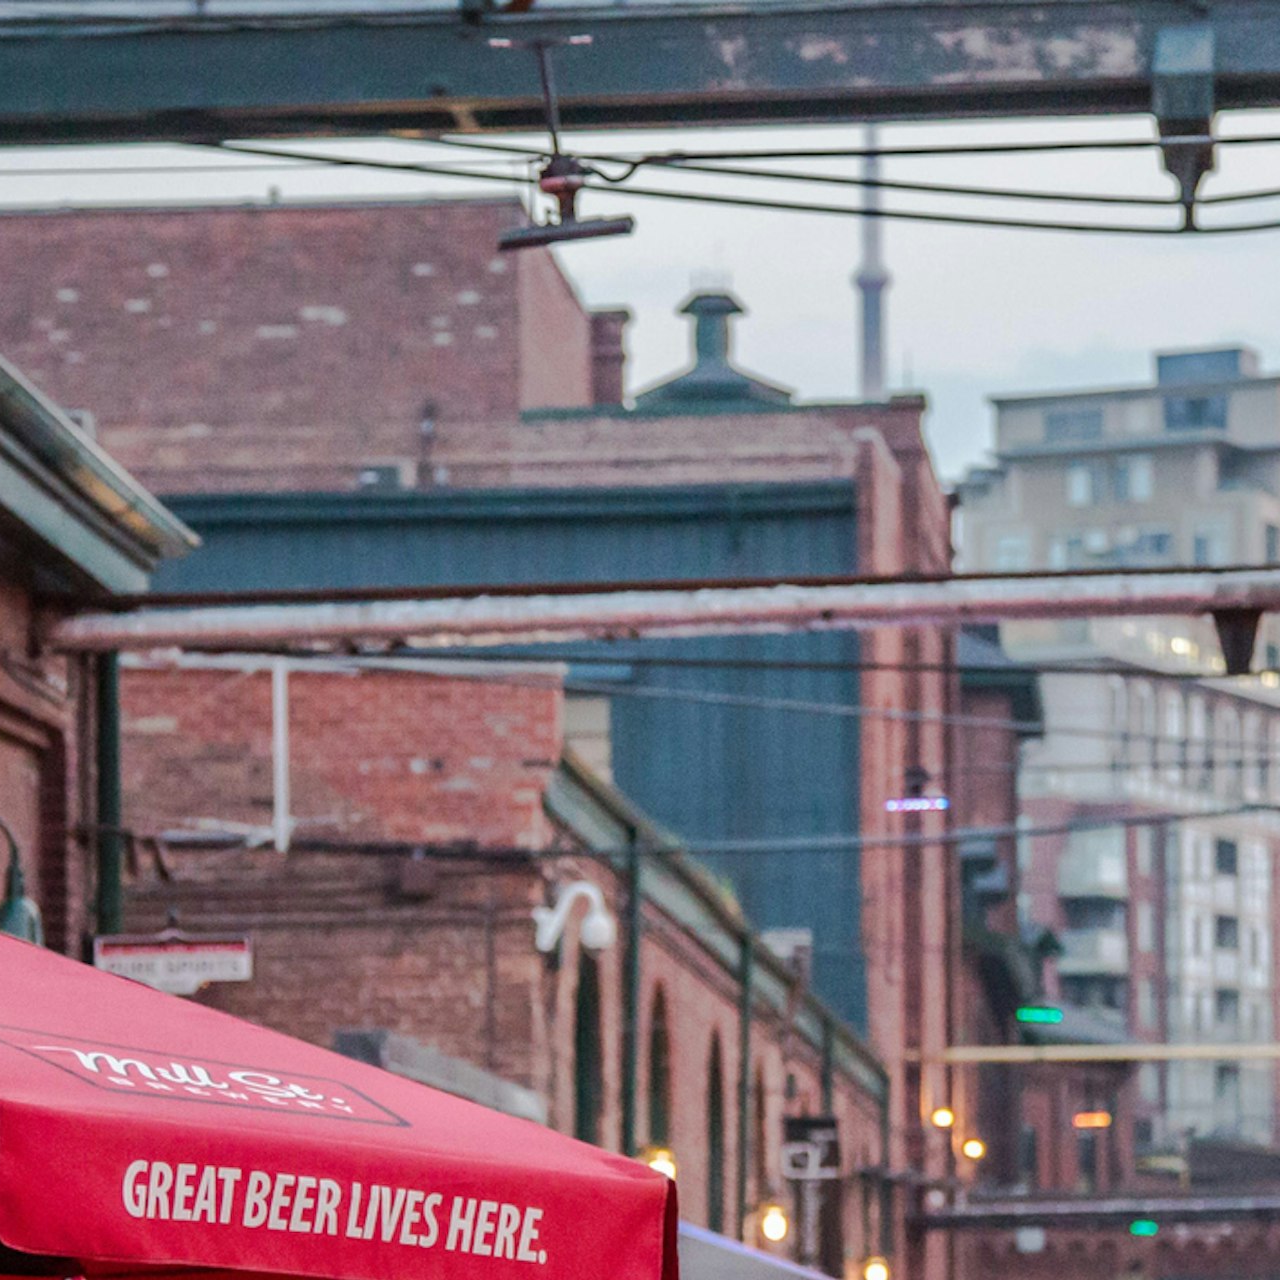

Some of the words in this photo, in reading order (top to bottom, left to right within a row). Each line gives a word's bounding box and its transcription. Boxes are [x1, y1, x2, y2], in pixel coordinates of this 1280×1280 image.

[32, 1046, 229, 1089] Mill
[122, 1159, 242, 1224] GREAT
[242, 1169, 342, 1236] BEER
[345, 1182, 442, 1249] LIVES
[445, 1195, 548, 1266] HERE.
